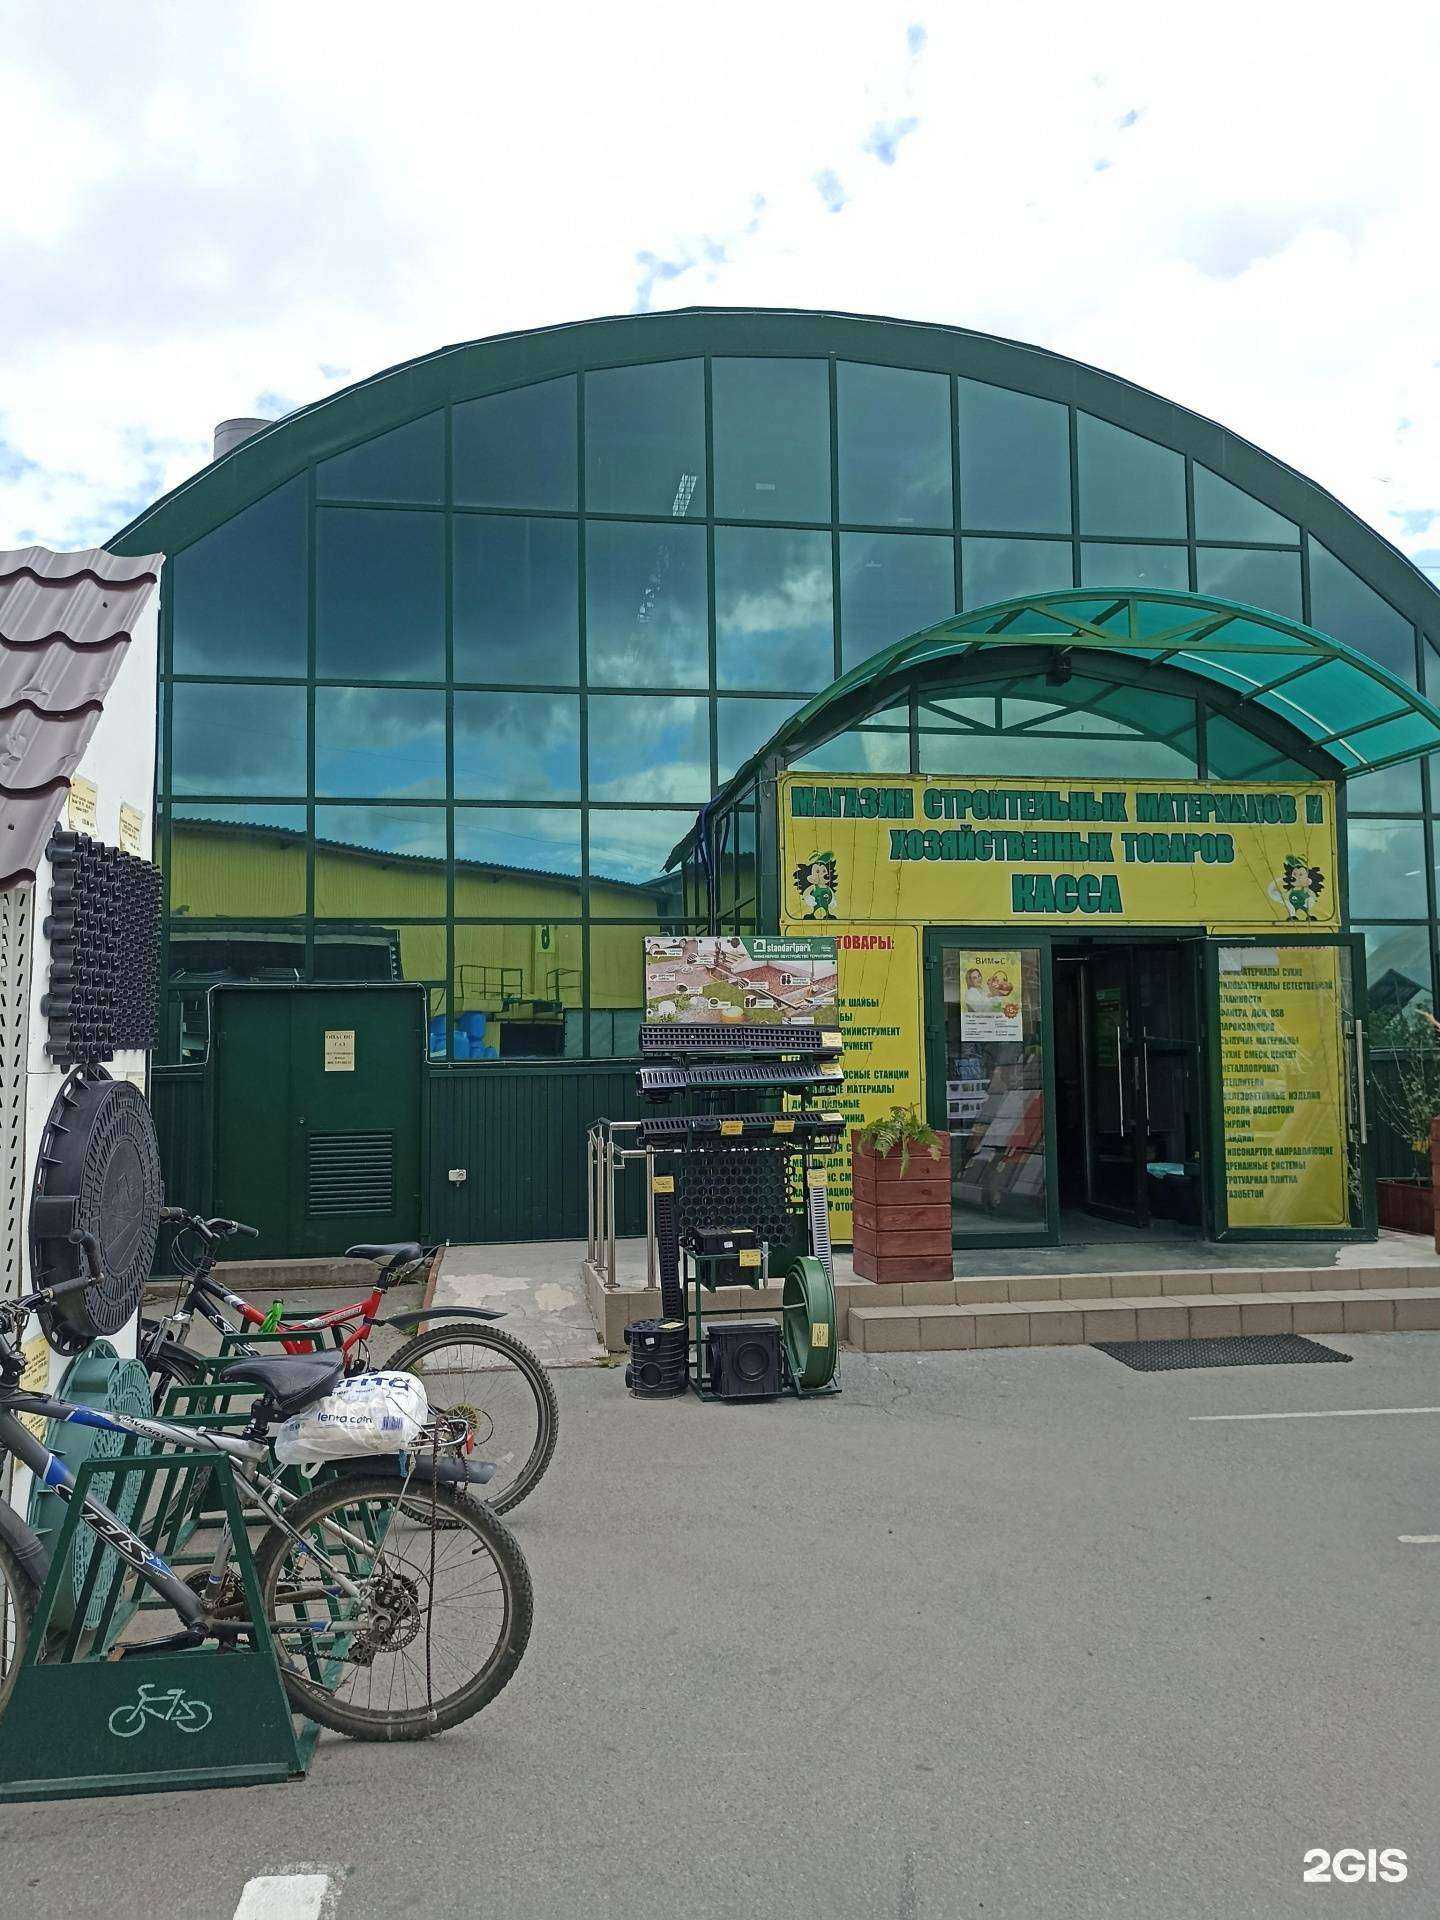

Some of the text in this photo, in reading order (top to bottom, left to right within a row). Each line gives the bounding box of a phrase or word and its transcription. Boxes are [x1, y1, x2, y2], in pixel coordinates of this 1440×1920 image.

[791, 787, 1323, 823] МАГАЗИН СТРОИТЕЛЬНЫХ МАТЕРИАЛОВ И
[890, 826, 1235, 862] ХОЗЯЙСТВЕННЫХ ТОВАРОВ
[1012, 873, 1123, 913] КАССА
[767, 943, 812, 955] standartpark
[848, 998, 879, 1008] ШАЙБЫ
[874, 1070, 909, 1081] СТАНЦИИ
[847, 1084, 895, 1094] МАТЕРИАЛЫ
[1227, 1189, 1264, 1199] АЗОБЕТОН
